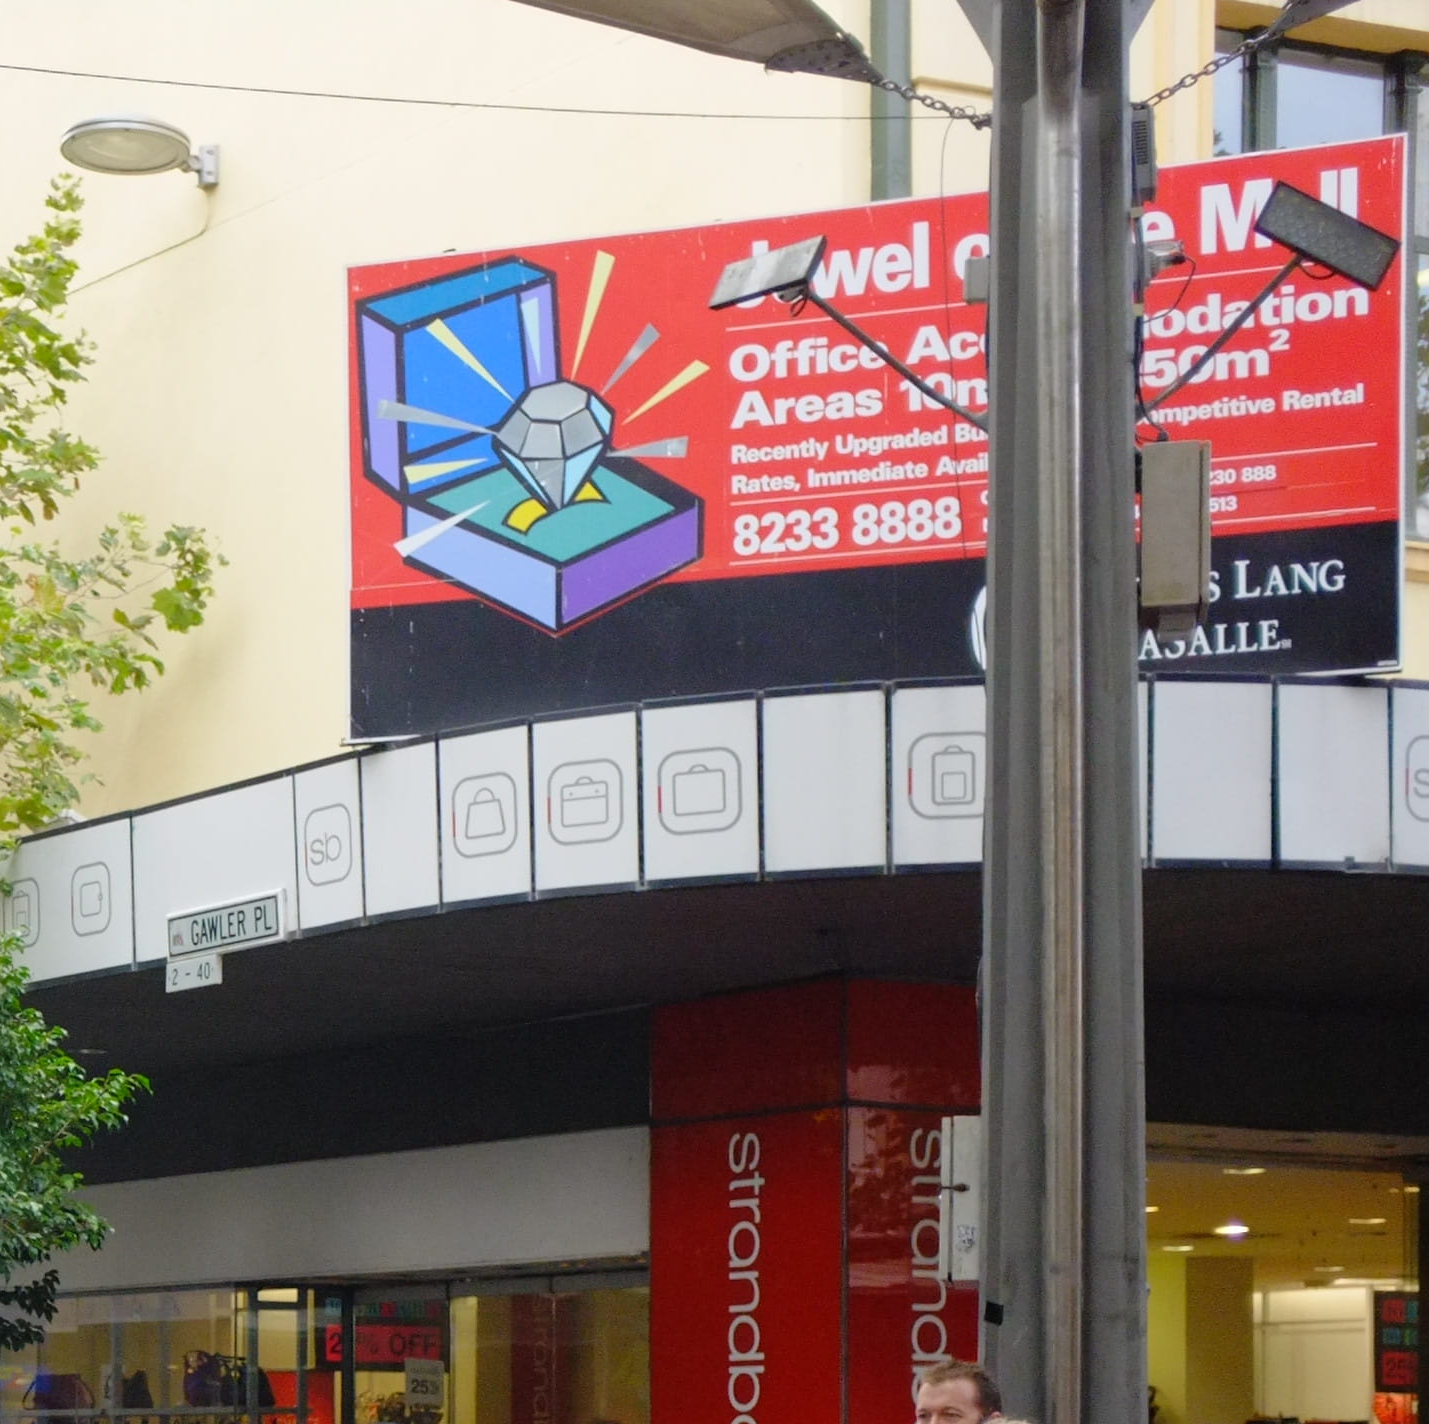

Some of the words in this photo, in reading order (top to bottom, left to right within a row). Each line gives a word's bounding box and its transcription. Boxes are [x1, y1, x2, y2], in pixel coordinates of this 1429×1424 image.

[735, 221, 930, 308] wel
[729, 336, 889, 382] Office
[730, 390, 884, 430] Areas
[731, 438, 829, 465] Recently
[835, 425, 948, 458] Upgraded
[955, 423, 989, 443] Bu
[1137, 395, 1275, 426] ompetitive
[1282, 382, 1365, 411] Rental
[731, 473, 801, 495] Rates,
[807, 461, 929, 488] Immediate
[1242, 465, 1277, 483] 888
[733, 507, 839, 556] 8233
[852, 495, 962, 546] 8888
[1233, 559, 1347, 600] LANG
[309, 832, 342, 866] sb
[191, 910, 246, 946] GAWLER
[254, 904, 272, 933] PL
[171, 968, 179, 986] 2
[197, 961, 211, 980] 40
[910, 1126, 952, 1390] strand
[391, 1333, 438, 1357] OFF
